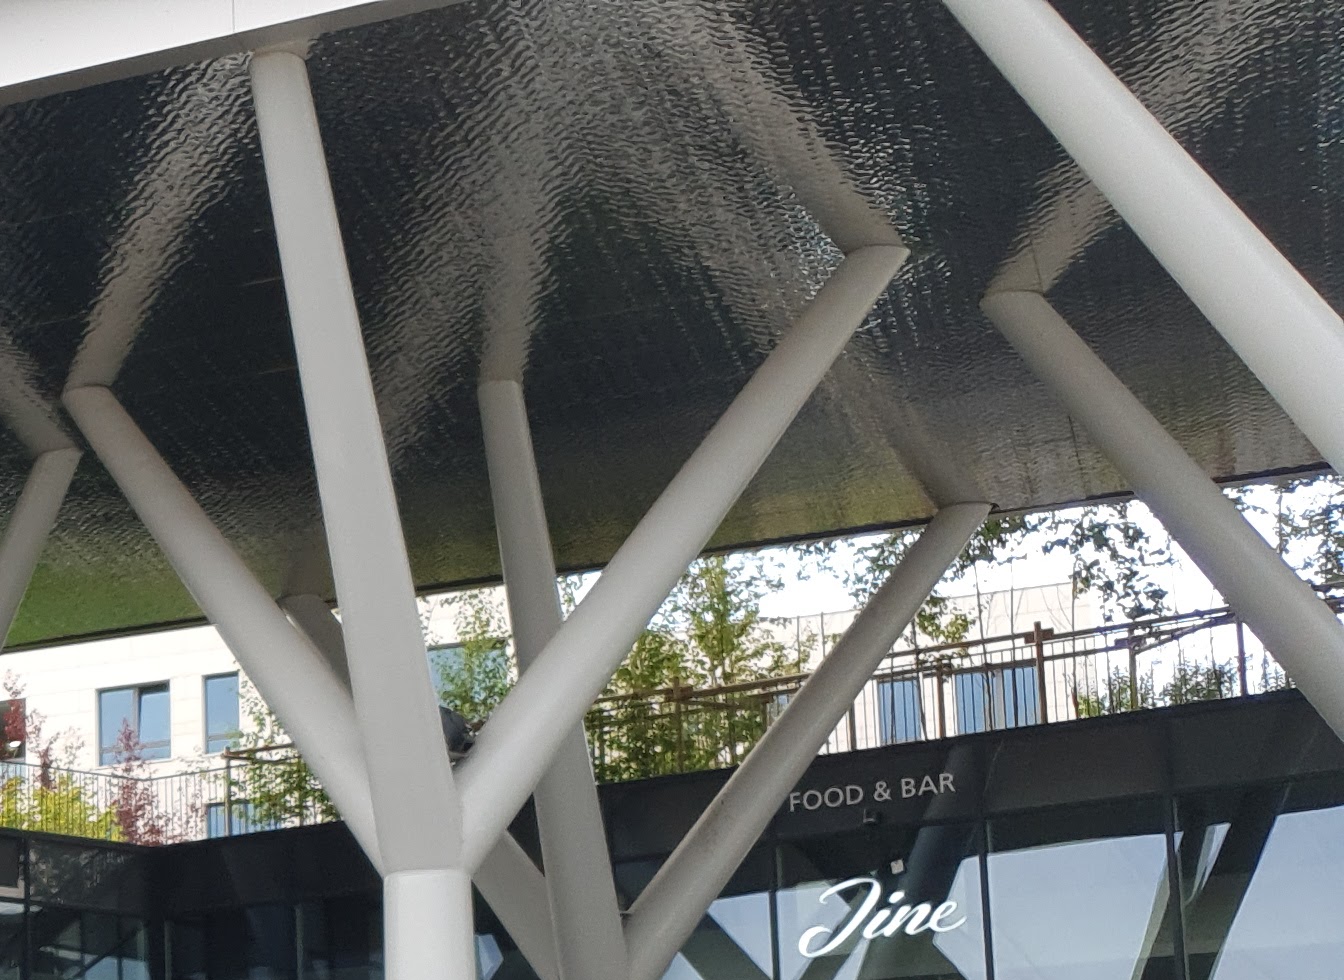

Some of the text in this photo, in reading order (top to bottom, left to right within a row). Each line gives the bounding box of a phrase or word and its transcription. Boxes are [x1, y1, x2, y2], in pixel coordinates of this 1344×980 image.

[789, 772, 956, 813] FOOD & BAR
